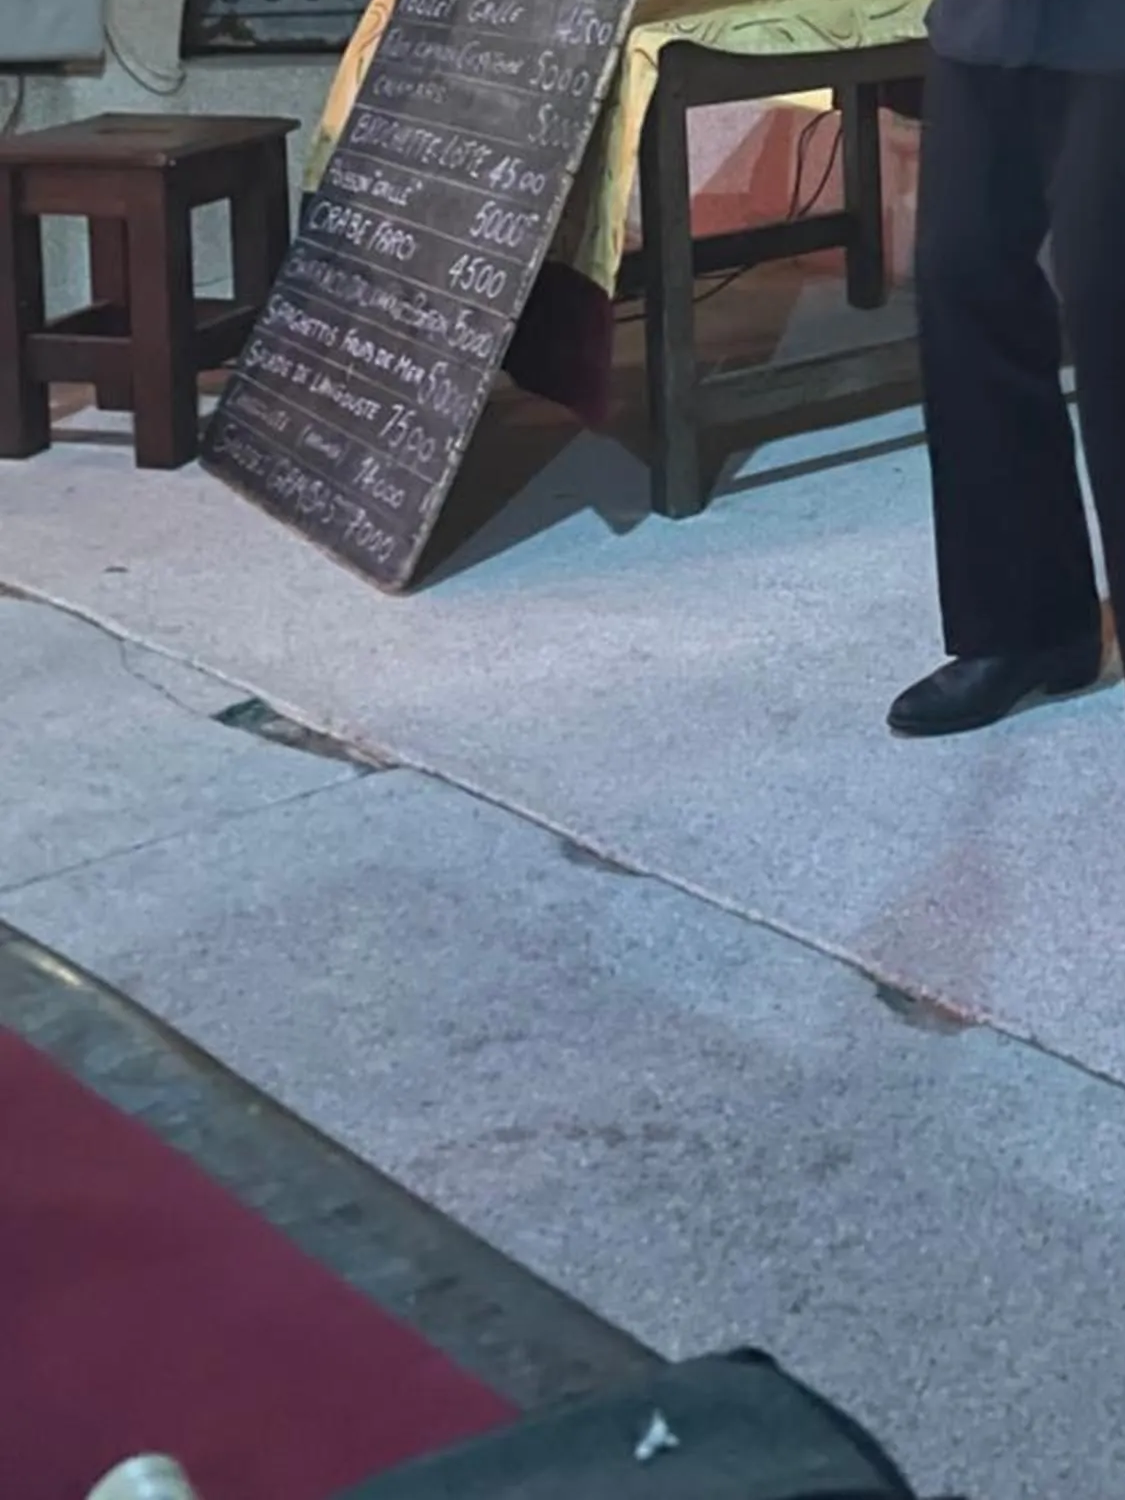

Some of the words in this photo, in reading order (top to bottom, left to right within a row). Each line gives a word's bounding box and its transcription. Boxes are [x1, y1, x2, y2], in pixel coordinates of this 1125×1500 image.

[528, 50, 591, 96] 5000
[488, 154, 547, 197] 4500
[308, 201, 373, 246] CRABE
[448, 253, 508, 300] 4500
[379, 402, 437, 463] 7500
